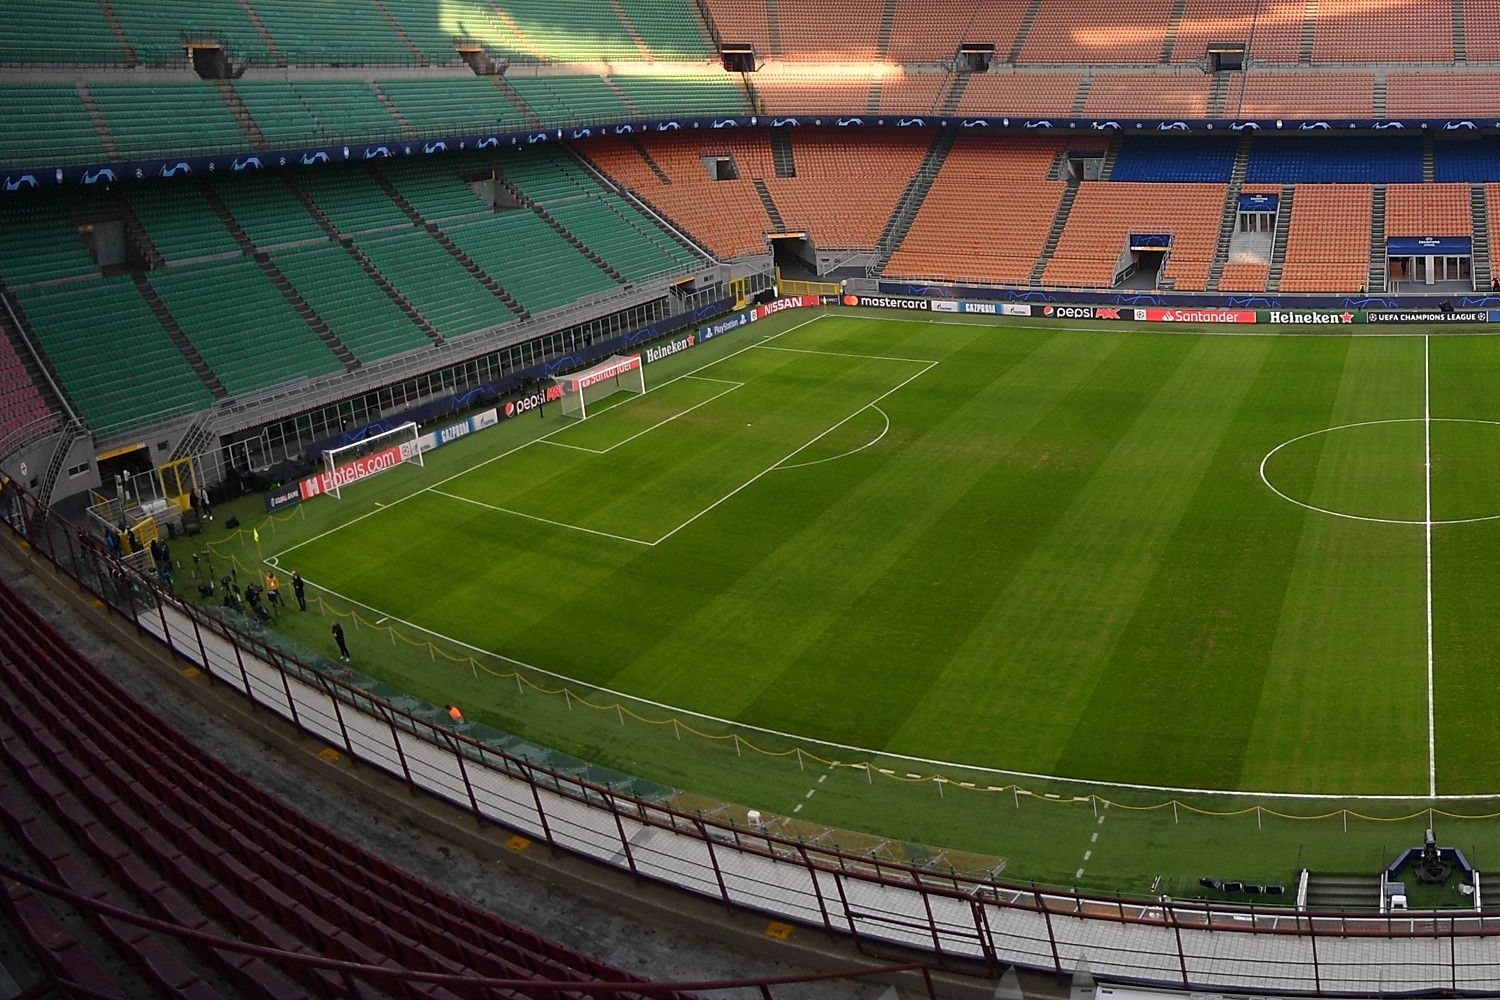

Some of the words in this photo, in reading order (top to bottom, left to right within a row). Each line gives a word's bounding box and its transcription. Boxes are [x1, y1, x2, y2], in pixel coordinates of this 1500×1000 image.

[764, 296, 802, 315] NISSAN
[861, 296, 928, 310] mastercard
[1057, 306, 1093, 319] pepsi
[1176, 311, 1239, 323] Santander
[1270, 311, 1339, 324] Heineken
[1378, 313, 1398, 321] UEFA
[1400, 313, 1445, 321] CHAMPIONS
[1447, 312, 1476, 321] LEAGUE
[714, 318, 738, 335] PlayStation
[647, 338, 687, 363] Heineken
[516, 390, 546, 415] pepsi
[321, 451, 395, 492] Hotels.com
